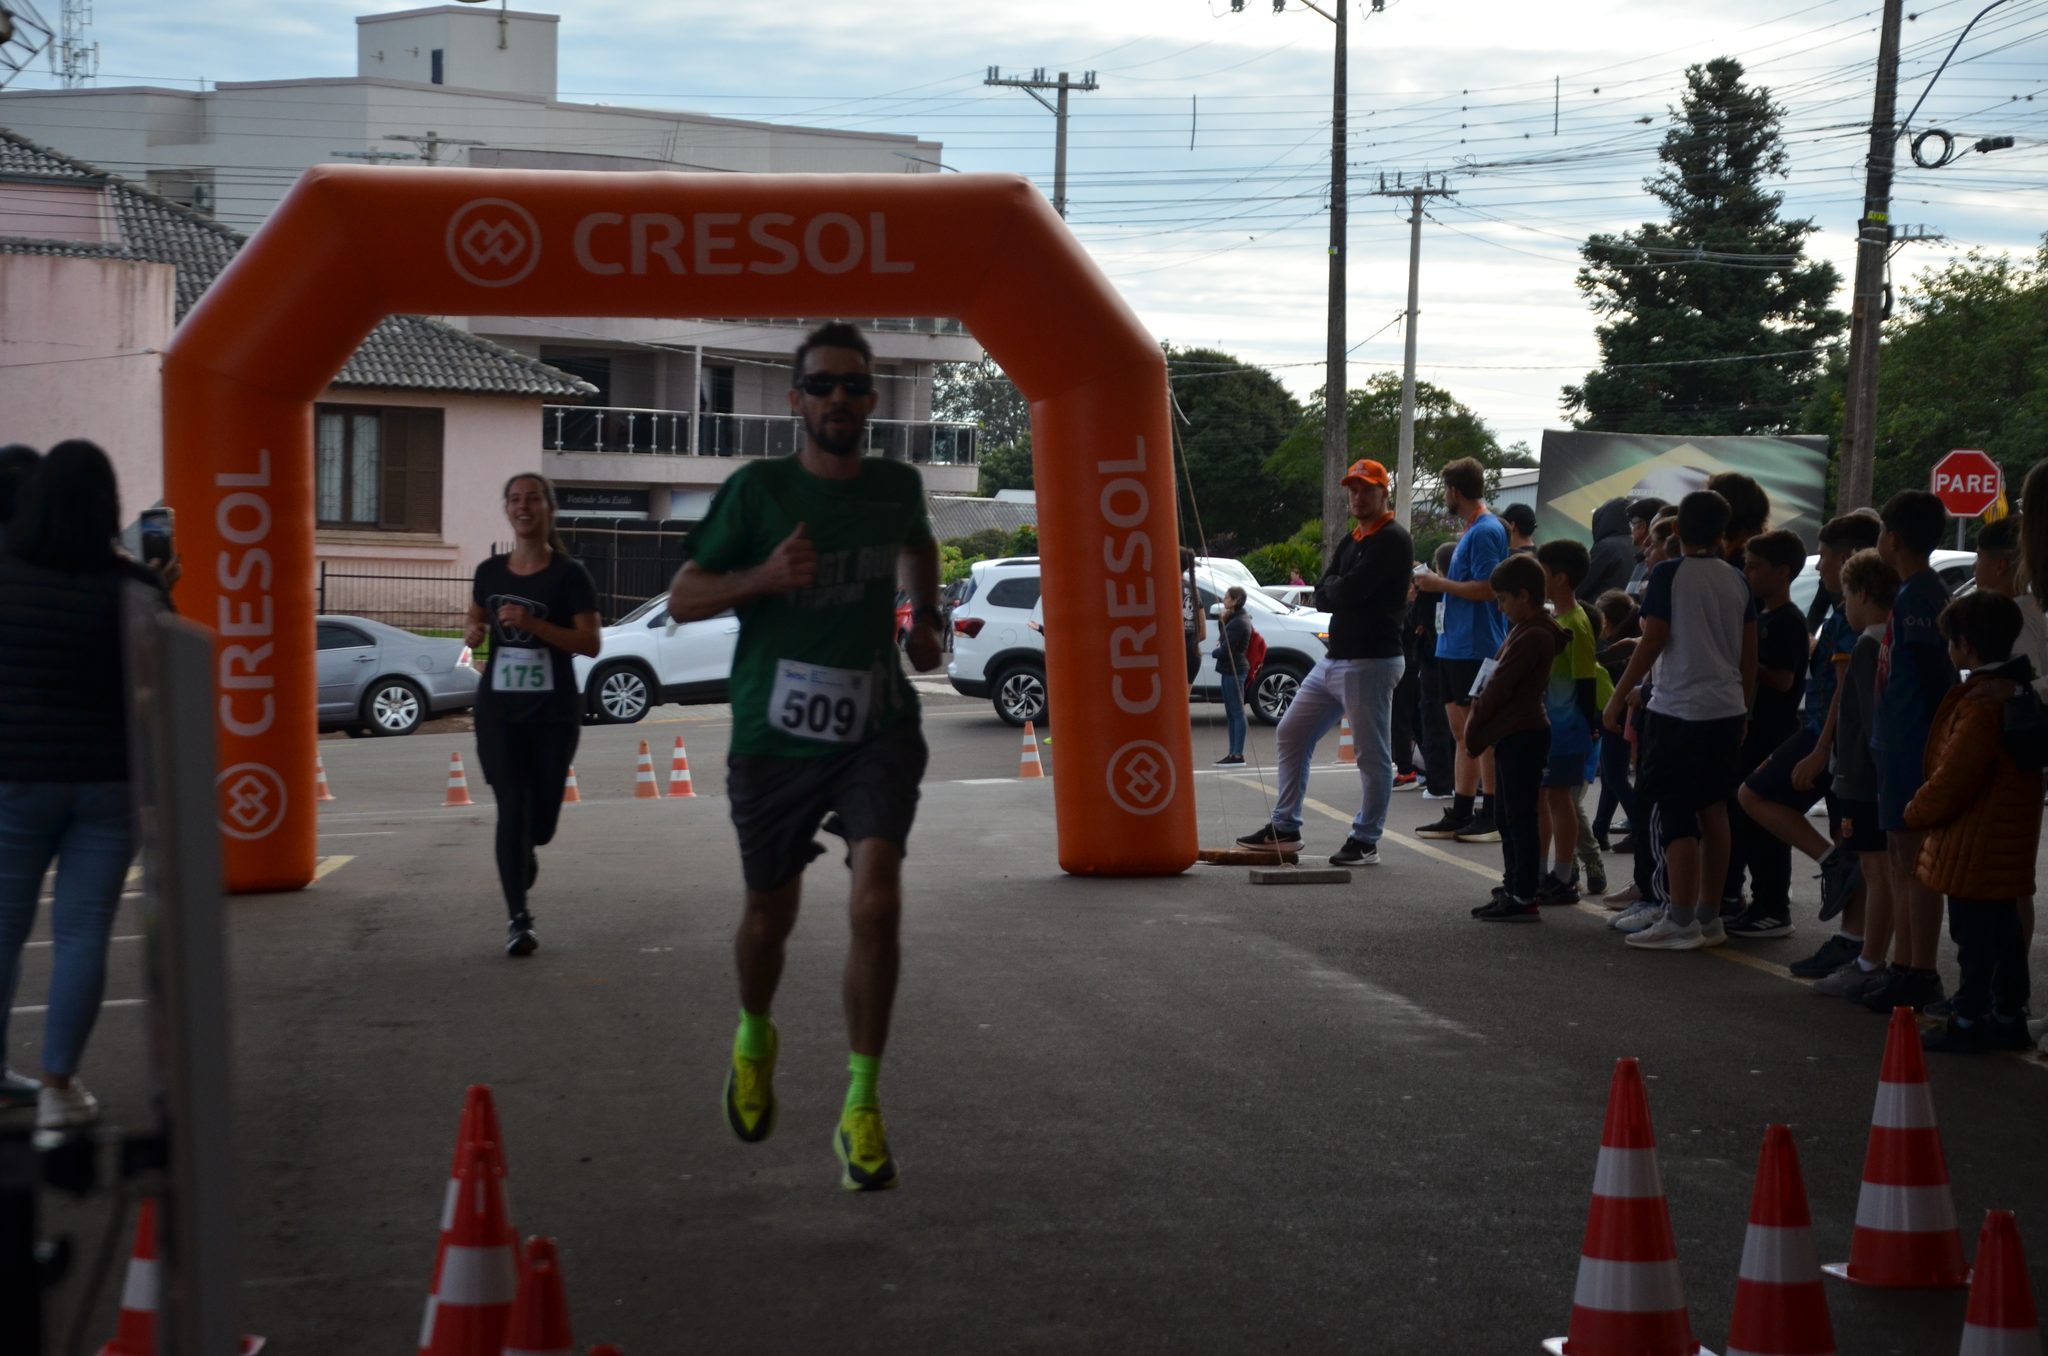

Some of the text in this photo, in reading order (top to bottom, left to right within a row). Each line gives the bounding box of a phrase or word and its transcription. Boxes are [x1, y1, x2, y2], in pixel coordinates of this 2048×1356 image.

[573, 211, 915, 275] CRESOL
[1936, 473, 1996, 494] PARE
[214, 448, 275, 736] CRESOL
[1098, 435, 1163, 715] CRESOL
[501, 664, 545, 687] 175
[781, 689, 857, 736] 509
